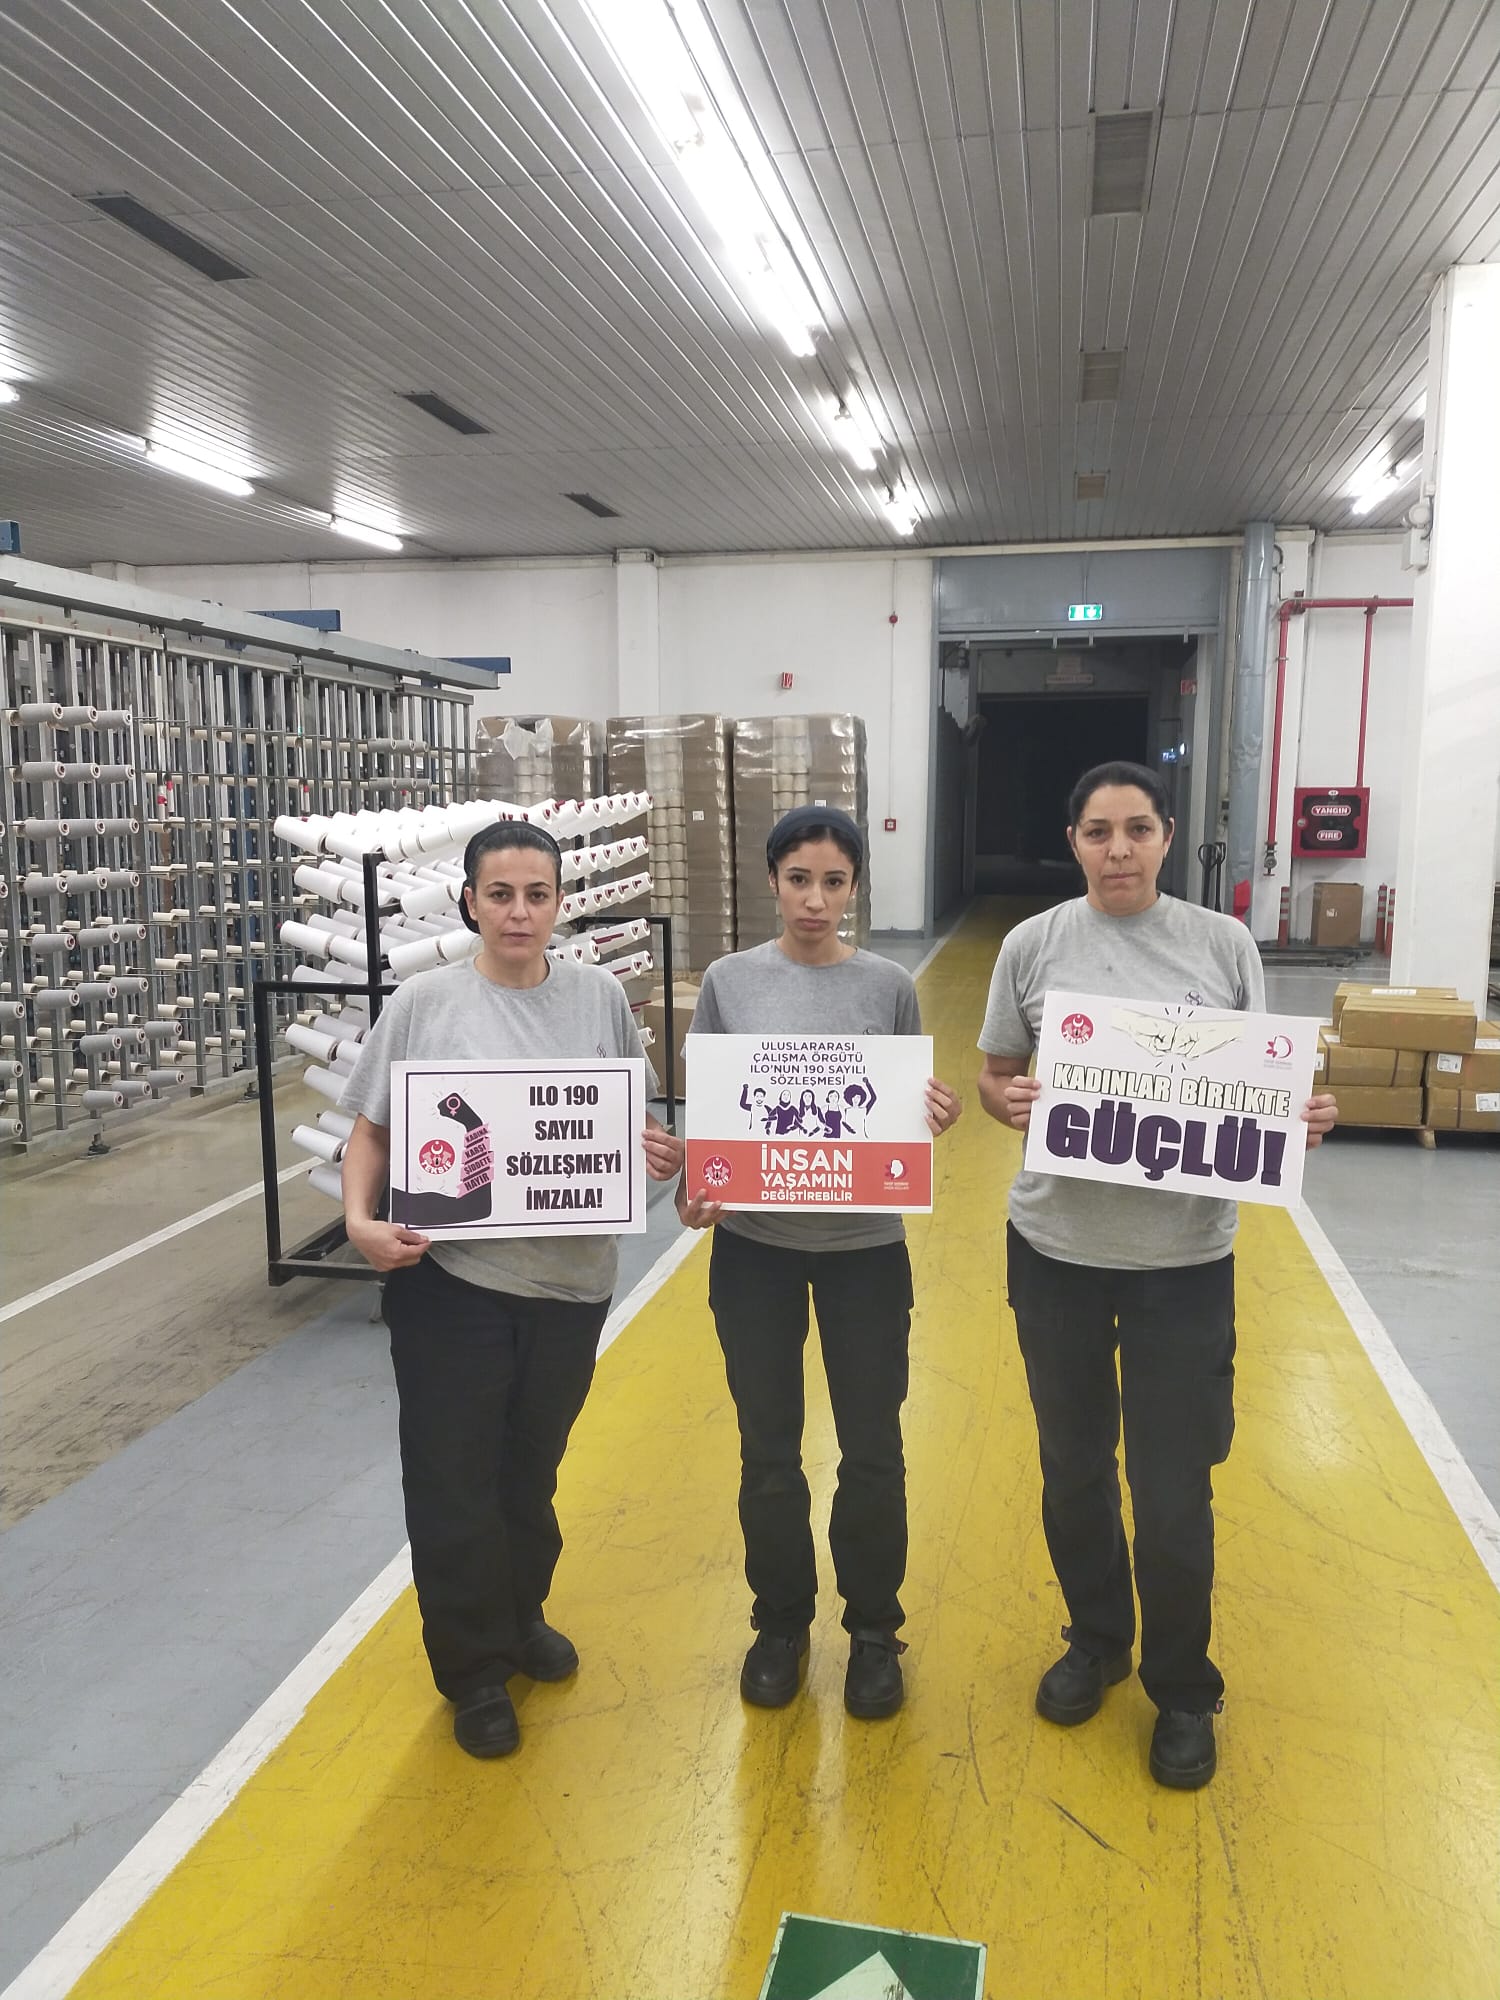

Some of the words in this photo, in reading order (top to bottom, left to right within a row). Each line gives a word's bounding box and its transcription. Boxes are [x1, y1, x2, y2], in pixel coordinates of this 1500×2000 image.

[761, 1041, 855, 1051] ULUSLARARASI
[753, 1053, 807, 1064] ÇALIŞMA
[811, 1051, 863, 1063] ÖRGÜTÜ
[750, 1064, 800, 1074] ILO'NUN
[804, 1065, 825, 1074] 190
[828, 1065, 866, 1075] SAYILI
[770, 1074, 846, 1087] SÖZLEŞMESİ
[1052, 1062, 1172, 1102] KADINLAR
[1180, 1076, 1291, 1117] BİRLİKTE
[529, 1085, 558, 1106] ILO
[563, 1084, 599, 1105] 190
[465, 1127, 489, 1143] KADINA
[534, 1119, 594, 1141] SAYILI
[1046, 1099, 1288, 1187] GÜÇLÜ!
[506, 1150, 622, 1178] SÖZLEŞMEYİ
[761, 1143, 853, 1172] İNSAN
[464, 1172, 490, 1191] HAYIR
[760, 1172, 853, 1190] YAŞAMINI
[526, 1186, 603, 1211] İMZALA!
[761, 1188, 853, 1203] DEĞİŞTİREBİLİR
